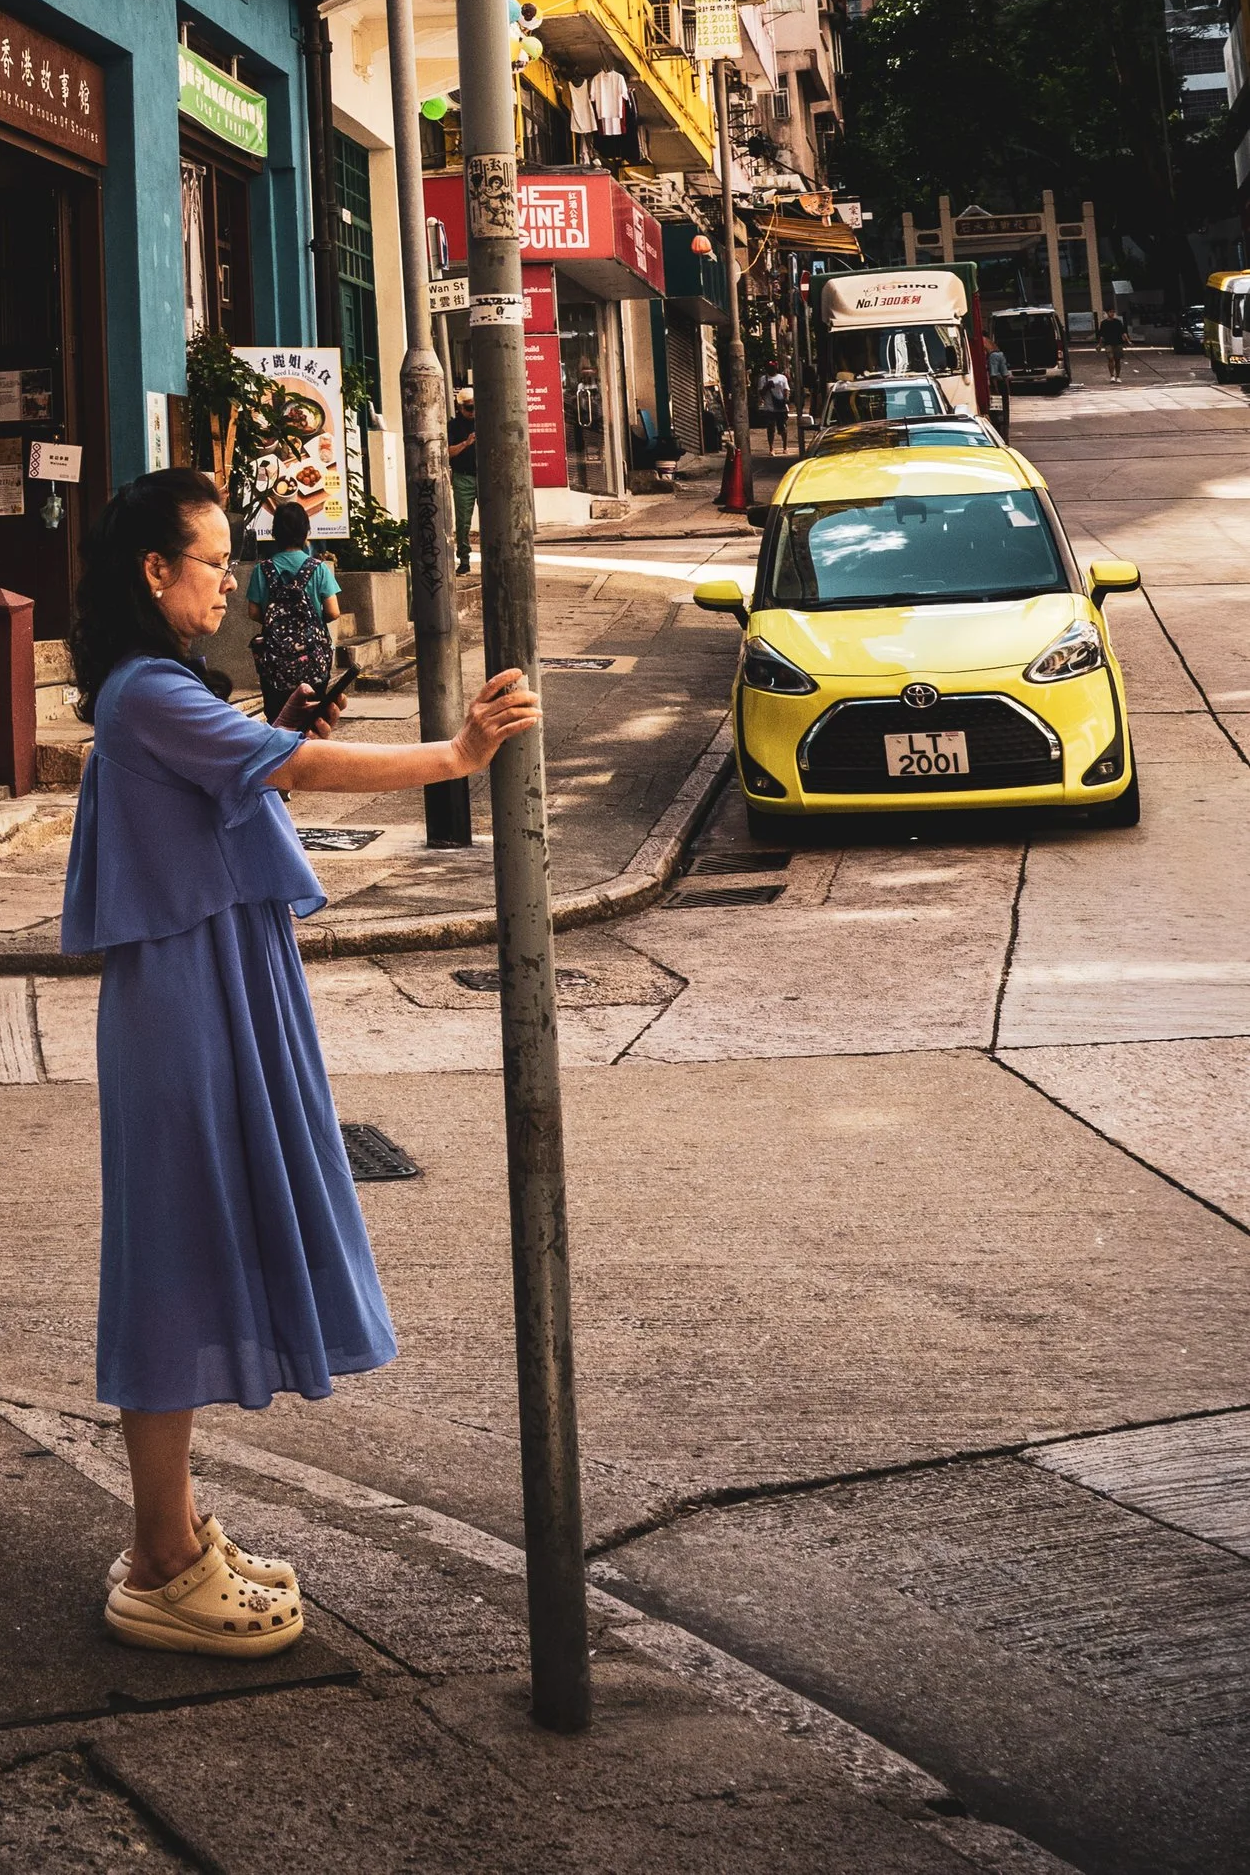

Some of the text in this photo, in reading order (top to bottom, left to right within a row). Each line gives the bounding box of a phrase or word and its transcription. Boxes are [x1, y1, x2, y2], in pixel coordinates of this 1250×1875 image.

[697, 13, 737, 24] 12.2018
[698, 25, 738, 35] 12.2018
[698, 36, 739, 47] 12.2018
[14, 93, 34, 116] Kong
[36, 104, 58, 125] House
[70, 120, 99, 145] Stories
[429, 282, 465, 294] Wan St
[907, 733, 943, 755] LT
[898, 752, 961, 775] 2001
